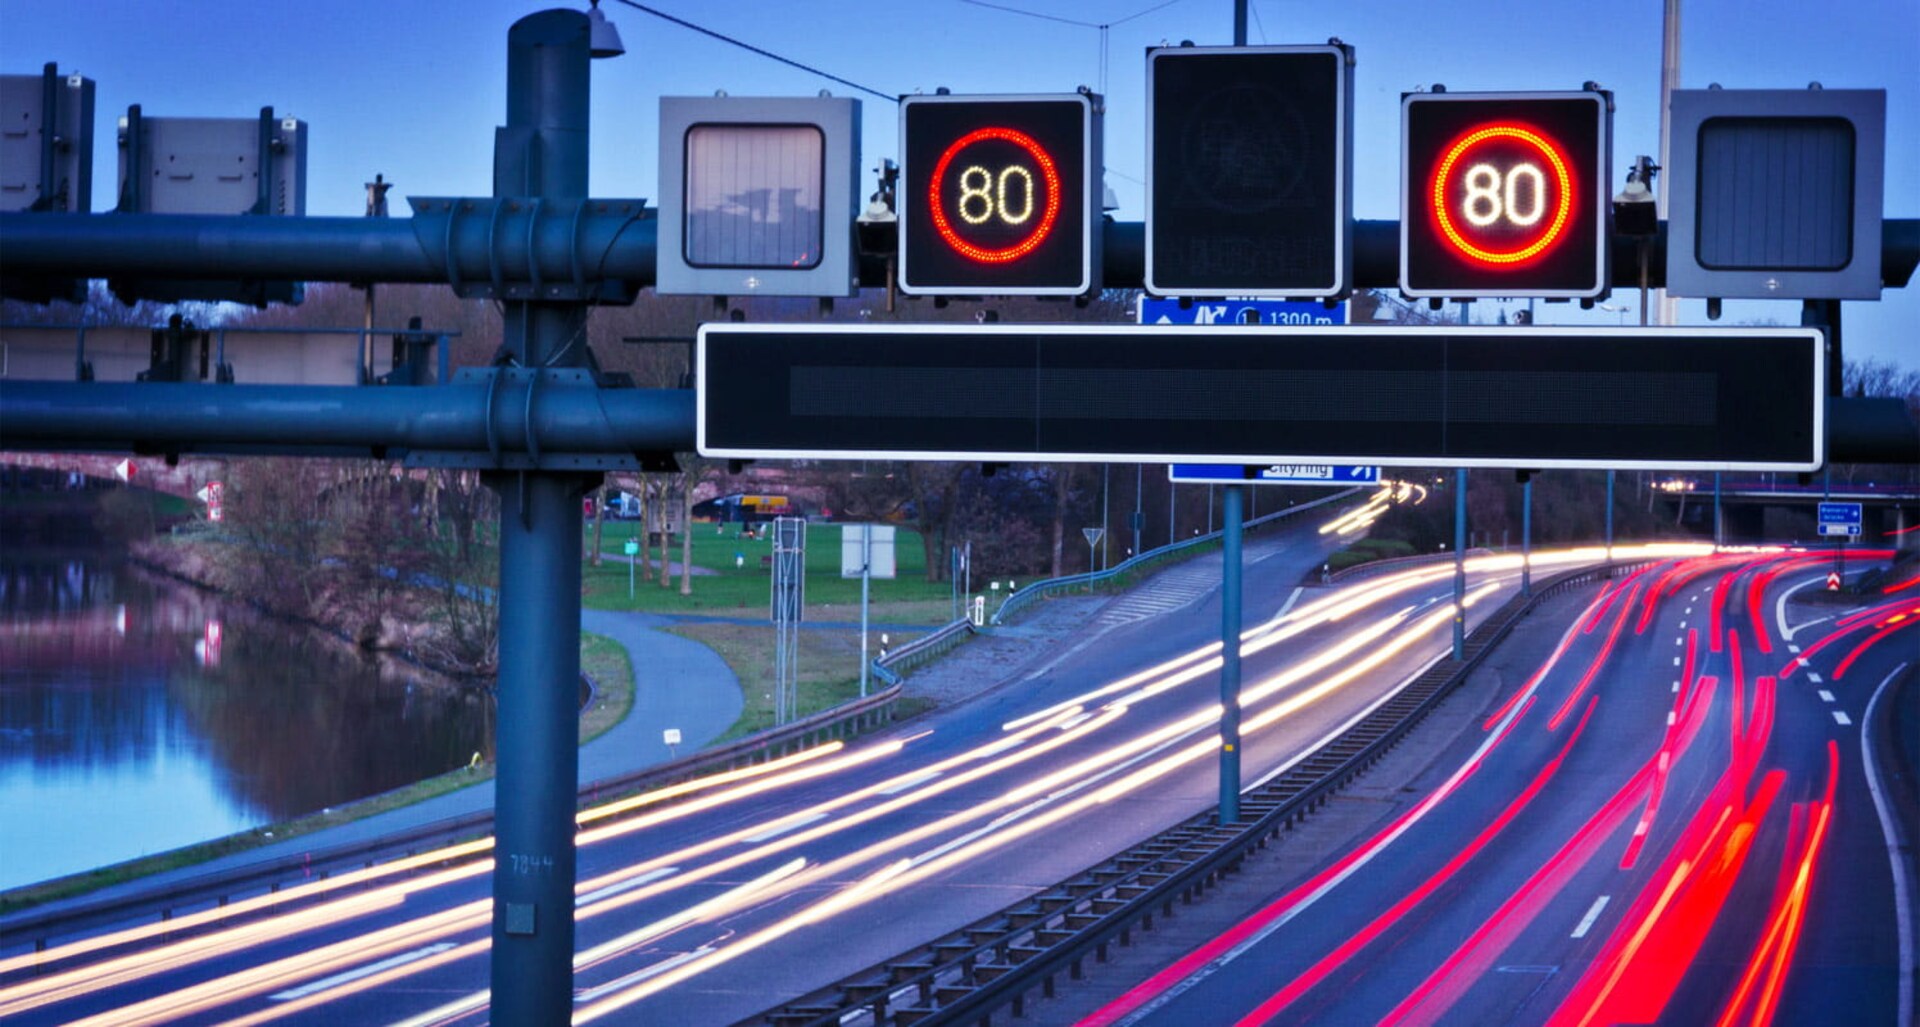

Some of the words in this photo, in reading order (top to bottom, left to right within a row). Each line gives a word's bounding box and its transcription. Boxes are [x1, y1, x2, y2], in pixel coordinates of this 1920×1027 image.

[960, 165, 1033, 225] 80
[1463, 163, 1545, 227] 80
[1270, 312, 1311, 325] 1300
